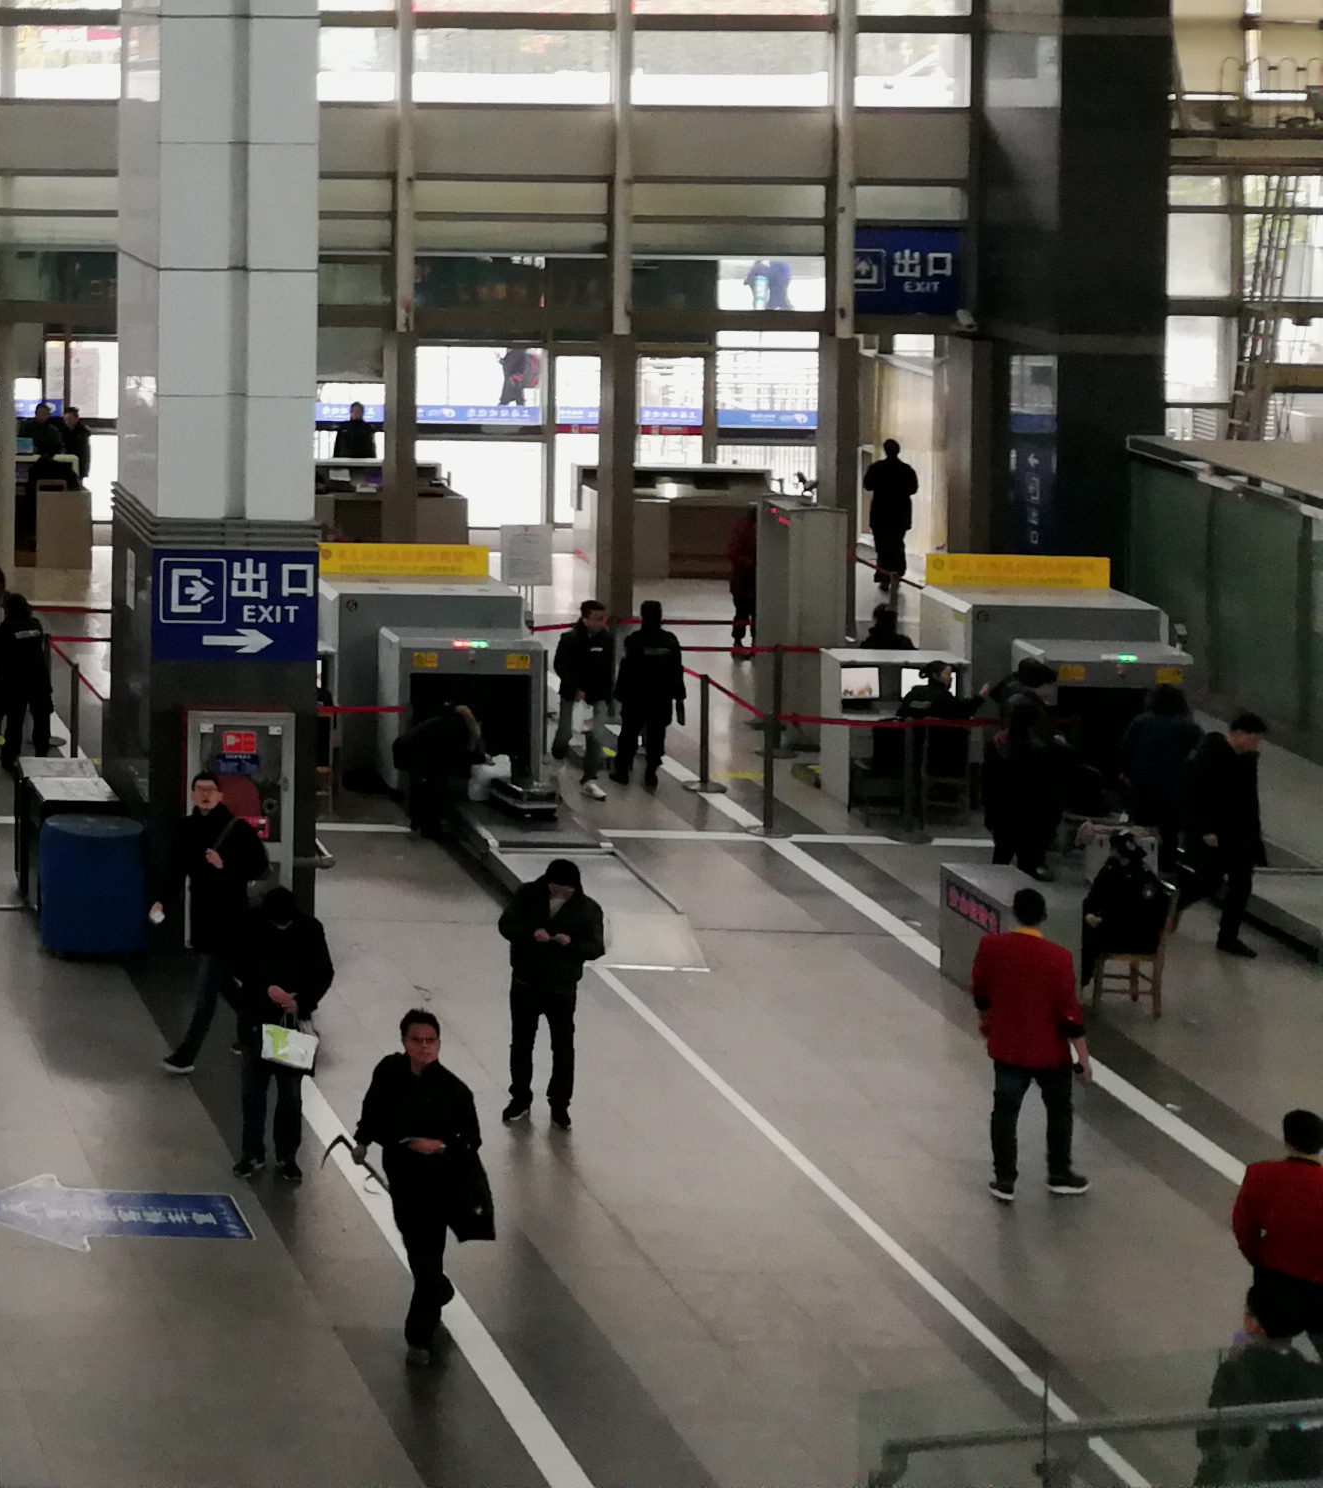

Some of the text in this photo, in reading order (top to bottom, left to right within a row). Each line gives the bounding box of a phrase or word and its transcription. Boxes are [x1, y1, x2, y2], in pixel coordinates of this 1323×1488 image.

[892, 248, 952, 277] 出口
[903, 281, 940, 293] EXIT
[230, 558, 315, 599] 出口
[242, 604, 300, 623] EXIT
